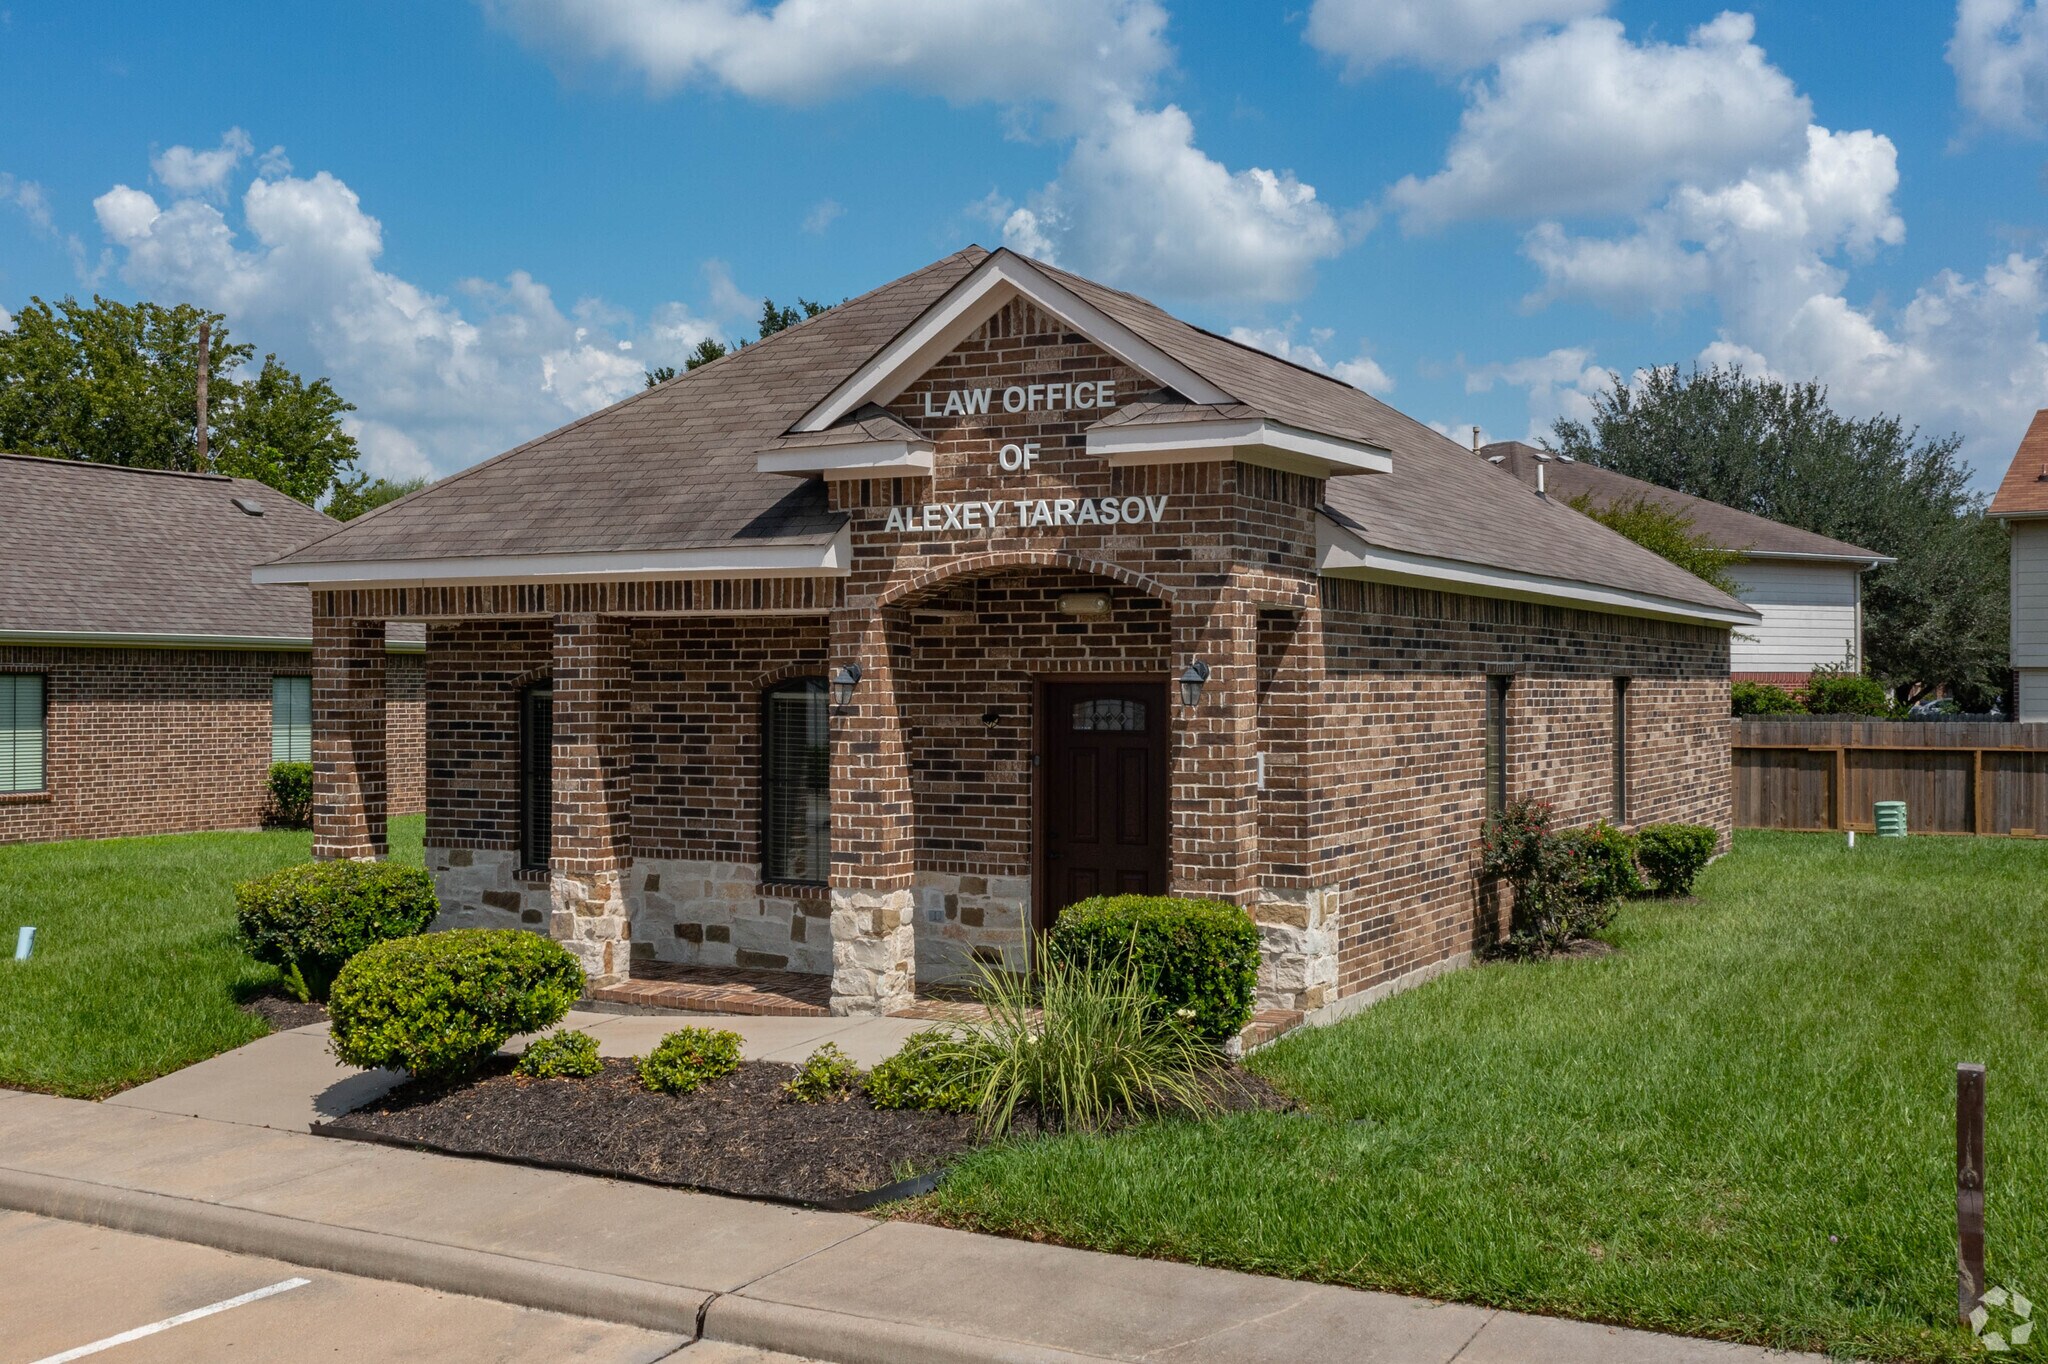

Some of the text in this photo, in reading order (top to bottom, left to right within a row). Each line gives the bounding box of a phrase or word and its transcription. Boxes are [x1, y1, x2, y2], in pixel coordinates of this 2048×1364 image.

[925, 380, 1116, 417] LAW OFFICE
[999, 443, 1041, 471] OF
[884, 495, 1168, 533] ALEXEY TARASOV
